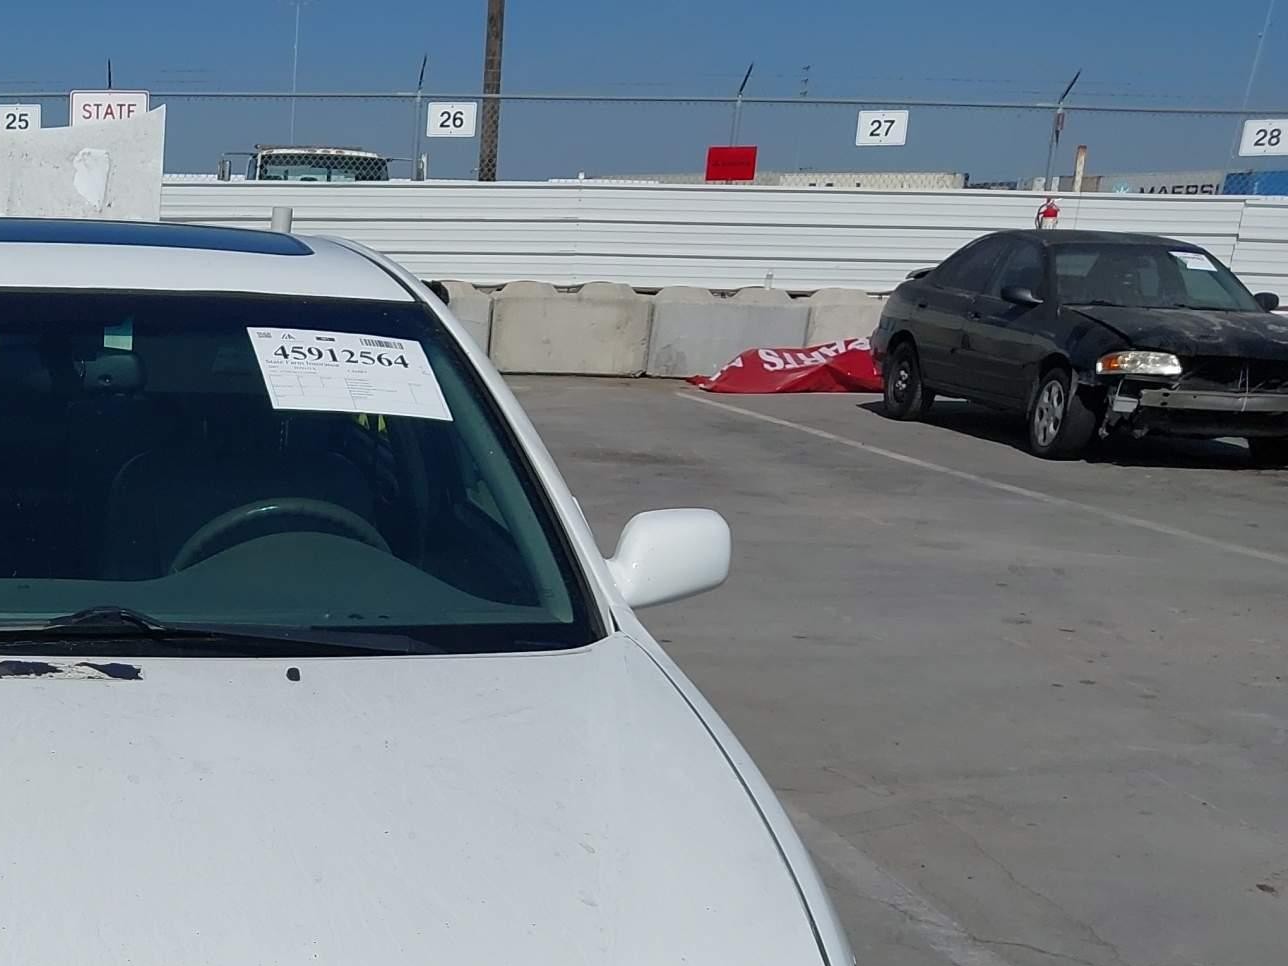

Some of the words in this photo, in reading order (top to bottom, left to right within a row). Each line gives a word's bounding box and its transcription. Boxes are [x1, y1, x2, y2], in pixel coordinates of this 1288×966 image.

[5, 113, 29, 130] 25
[439, 110, 464, 129] 26
[869, 119, 896, 137] 27
[1253, 128, 1282, 147] 28
[273, 344, 409, 369] 45912564
